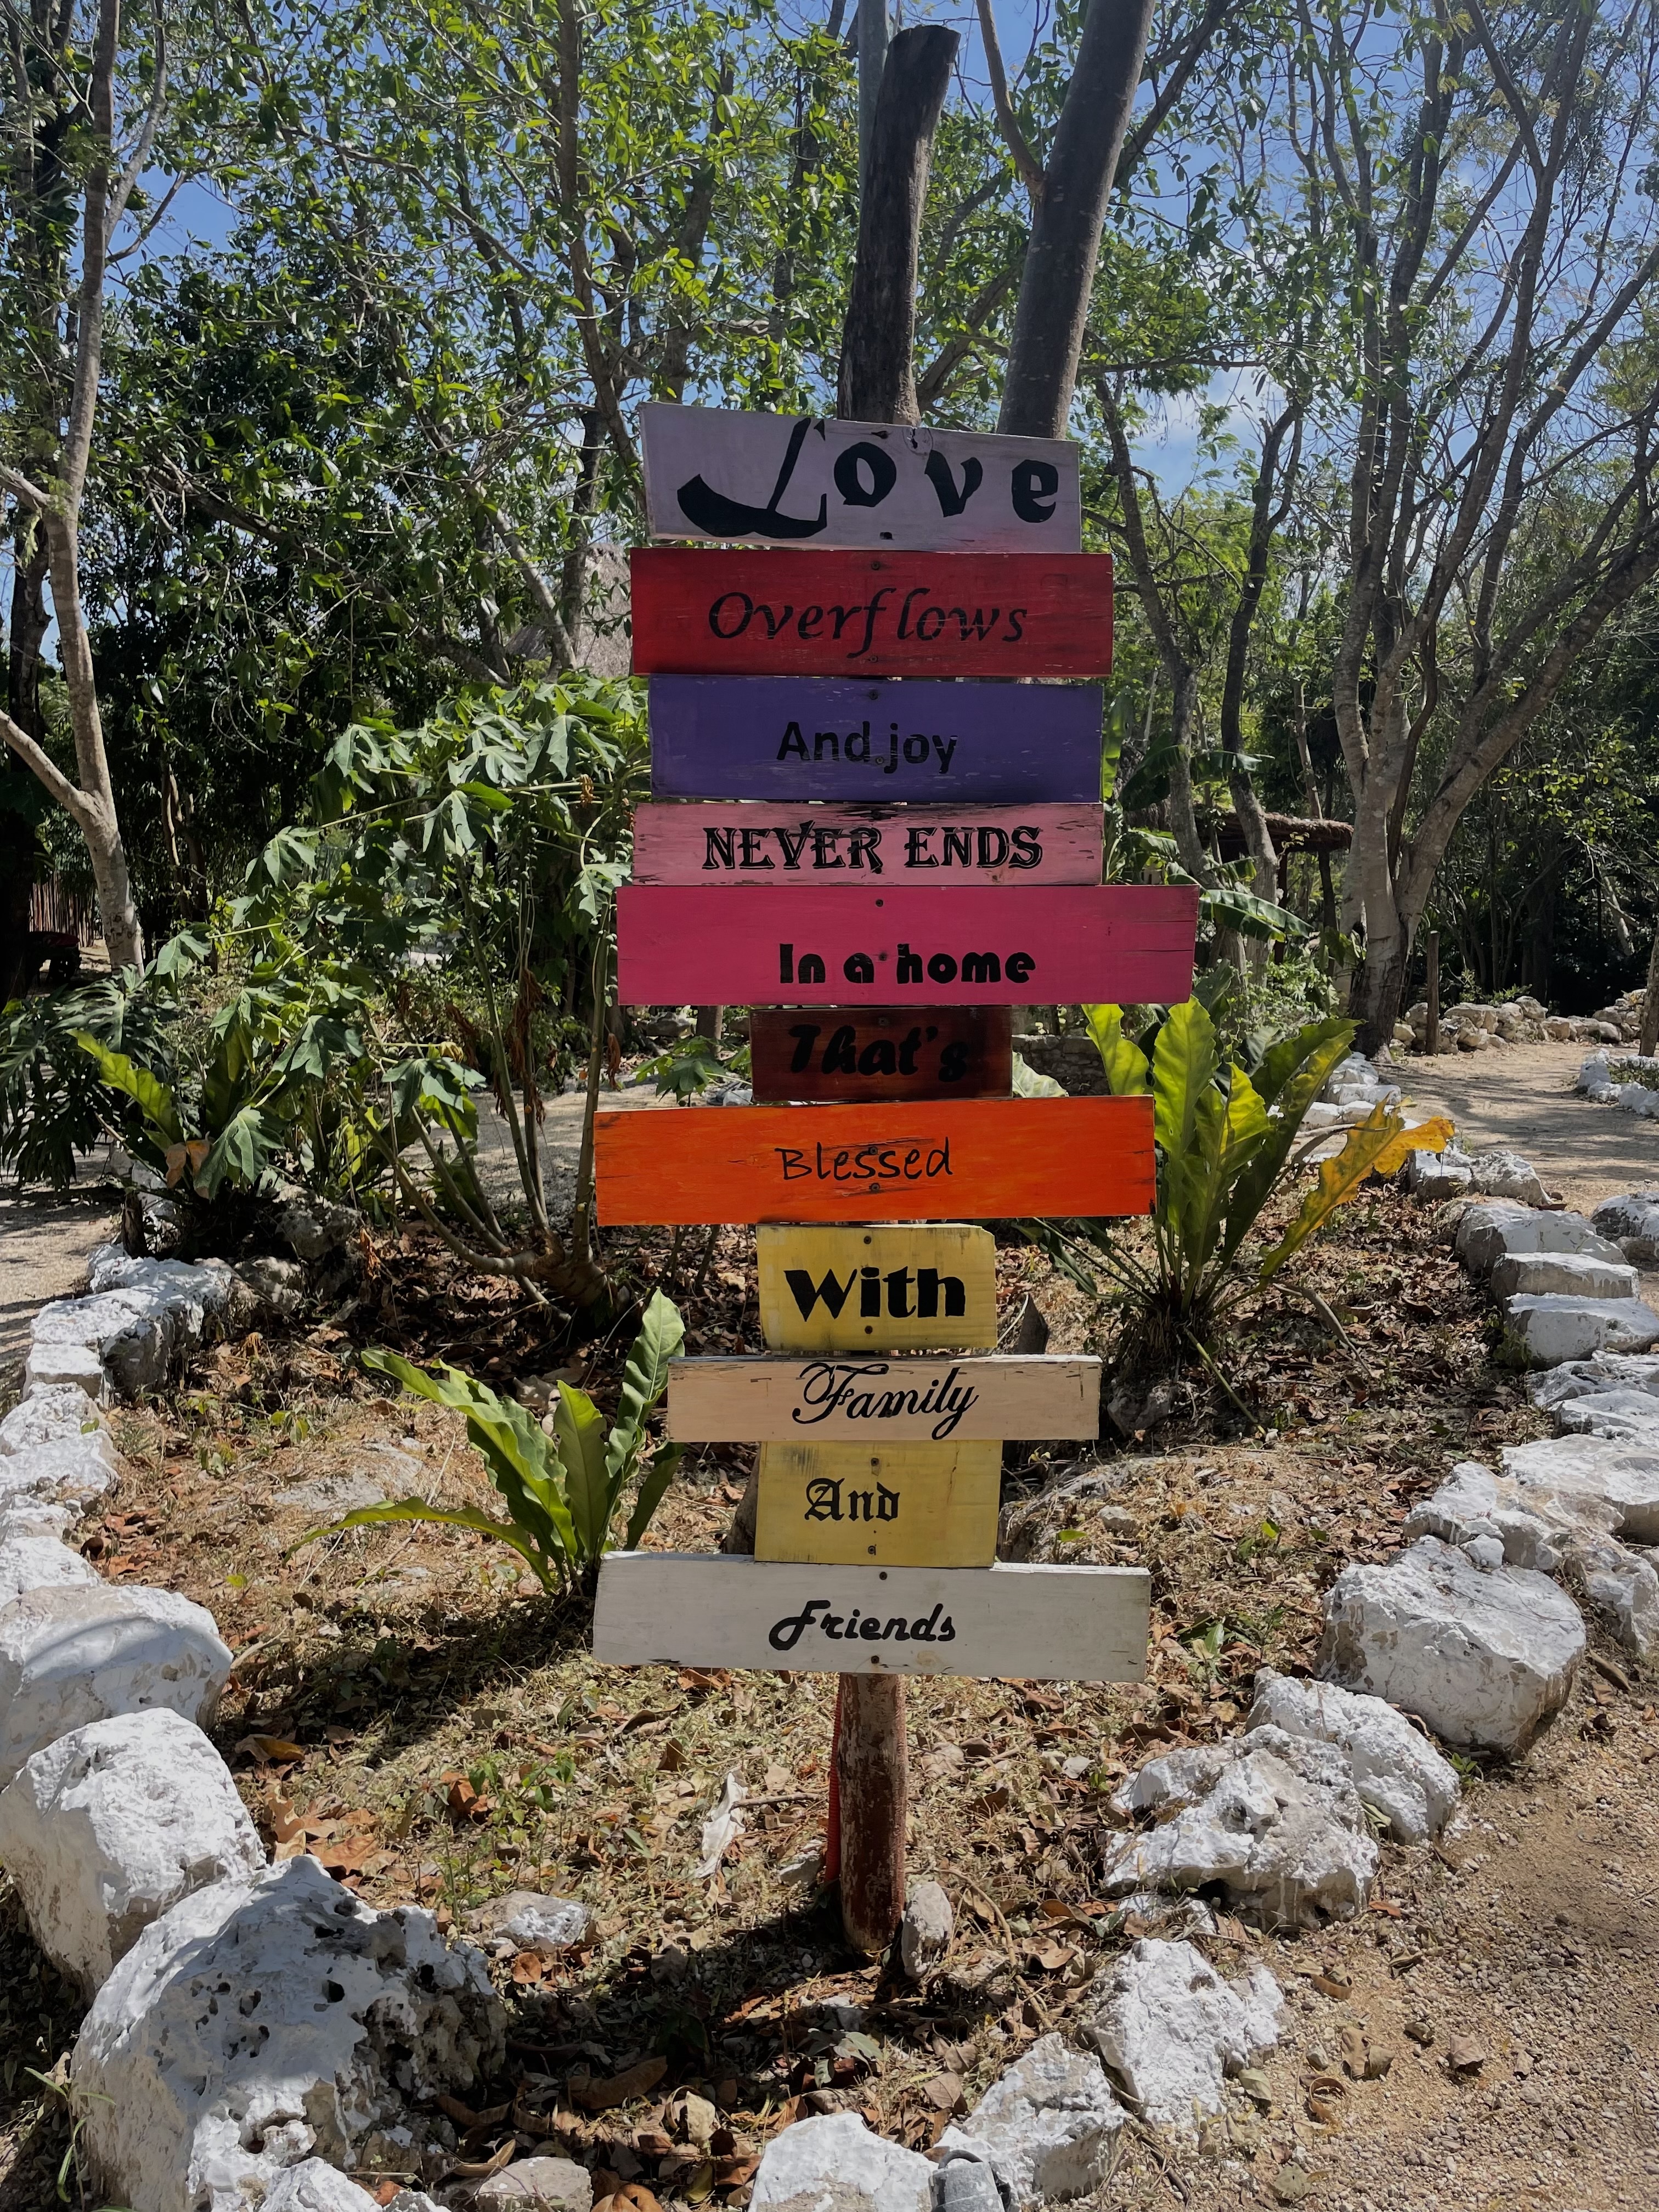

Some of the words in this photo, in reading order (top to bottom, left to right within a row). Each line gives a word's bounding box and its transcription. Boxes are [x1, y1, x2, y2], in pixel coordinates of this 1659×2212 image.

[676, 417, 1059, 538] Love
[777, 721, 870, 761] And
[883, 724, 957, 774] joy
[702, 820, 883, 871] NEVER
[904, 825, 1043, 868] ENDS
[780, 944, 826, 984] In
[843, 952, 874, 984] a
[896, 944, 1035, 985] home
[788, 1024, 970, 1082] That's
[775, 1137, 953, 1180] Blessed
[785, 1267, 966, 1322] With
[792, 1362, 979, 1440] Family
[804, 1478, 900, 1521] And
[769, 1600, 956, 1651] Friends
